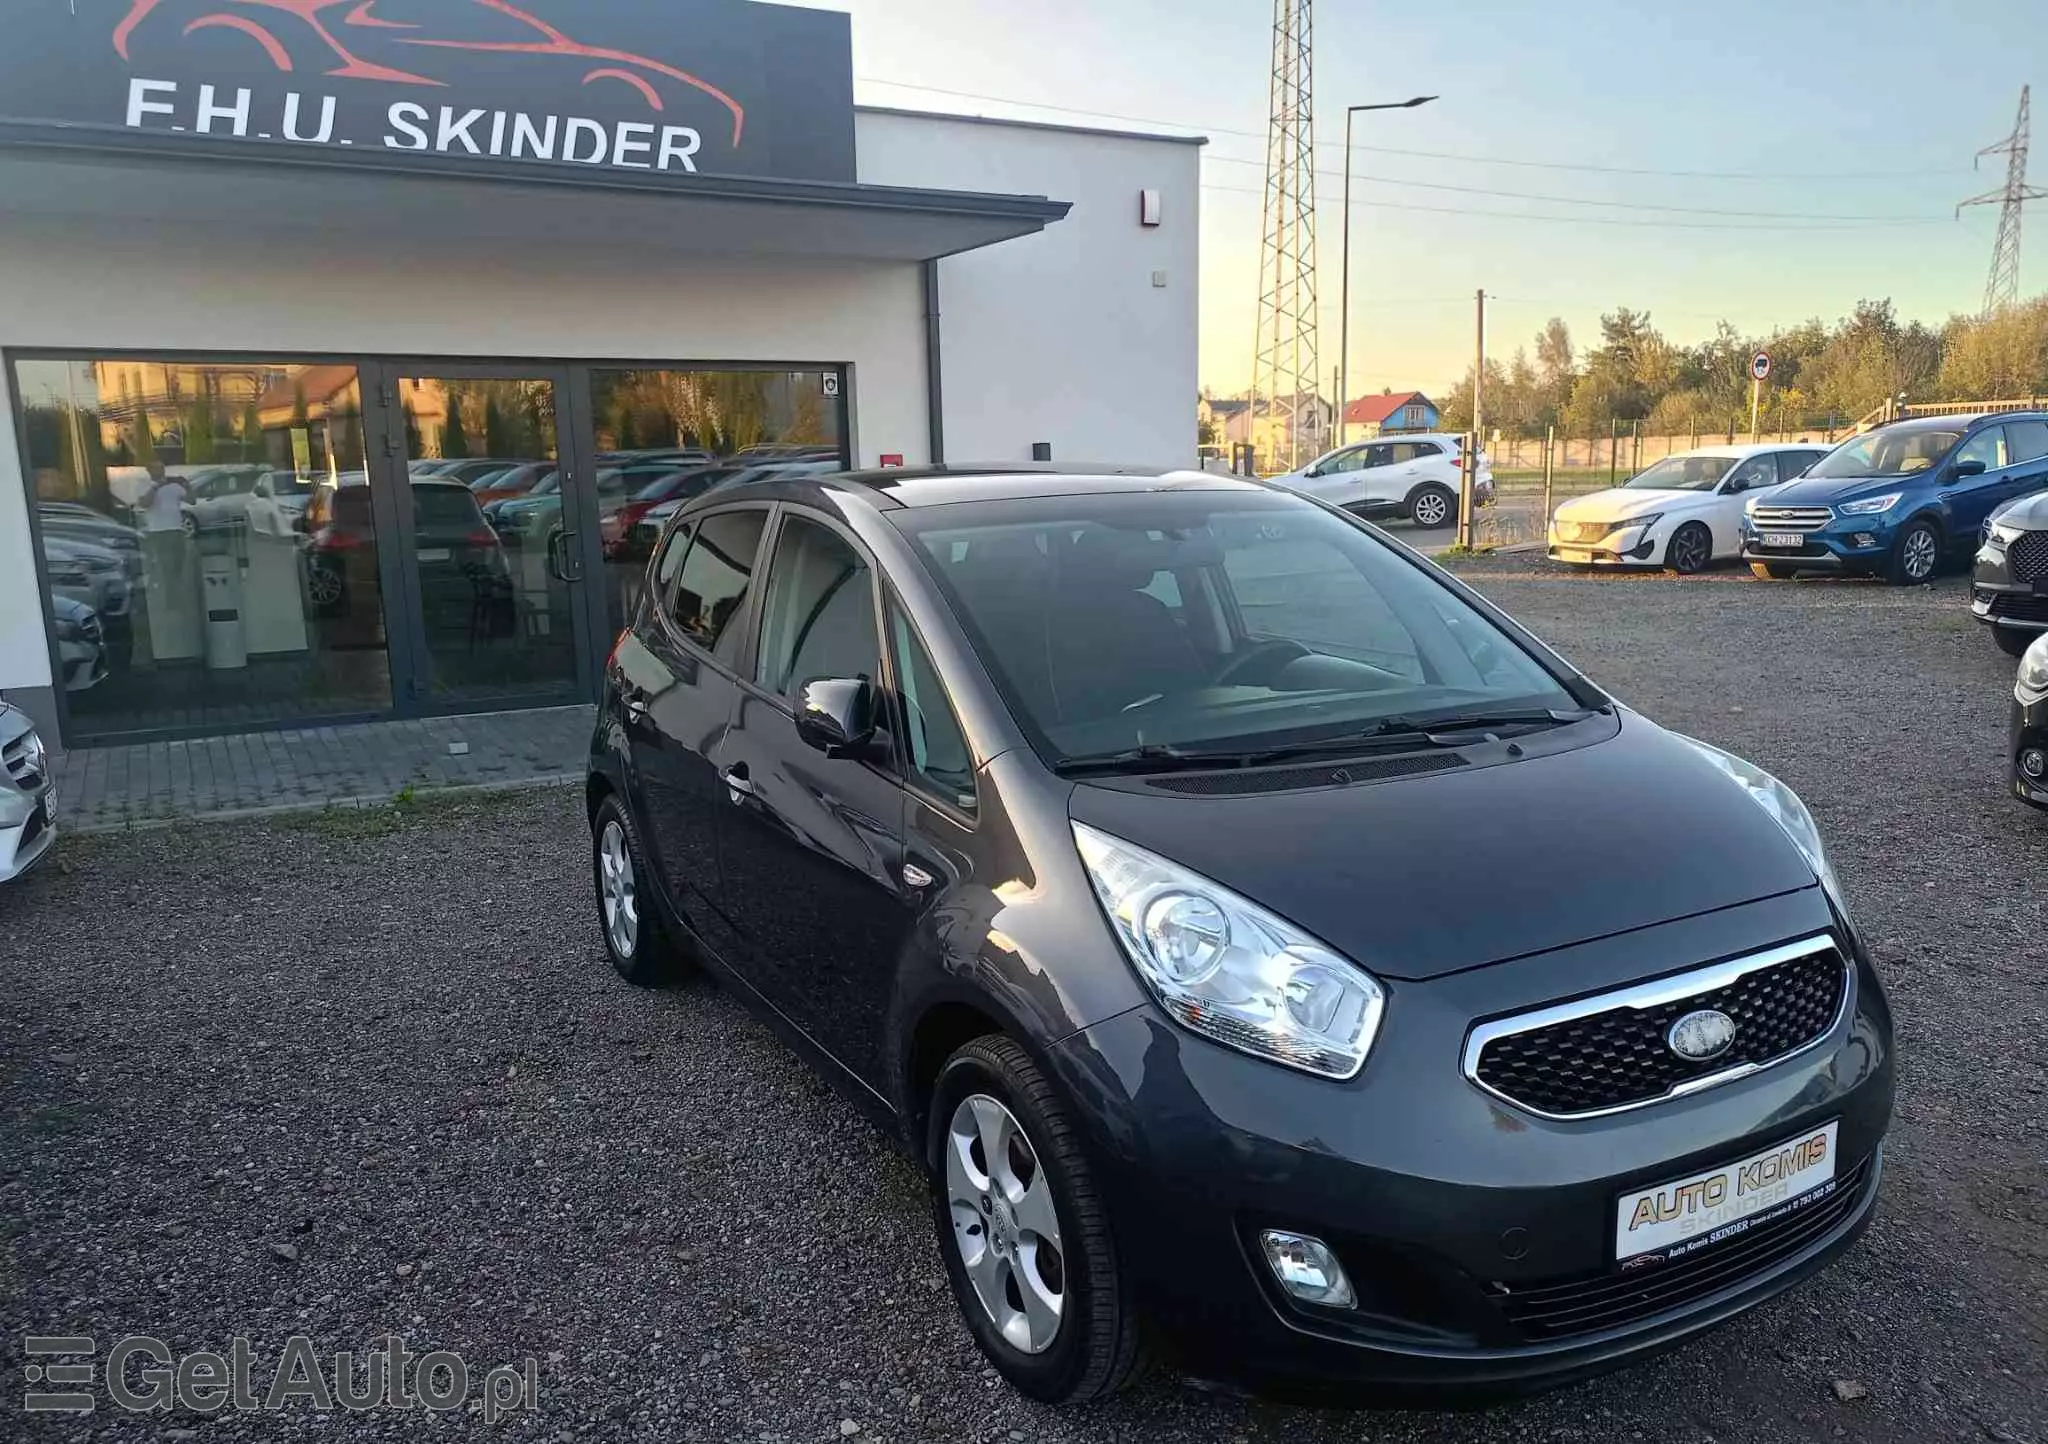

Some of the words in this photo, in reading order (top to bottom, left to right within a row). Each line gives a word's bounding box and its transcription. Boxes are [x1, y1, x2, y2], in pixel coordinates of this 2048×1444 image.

[383, 101, 702, 173] SKINDER
[1628, 1173, 1728, 1232] AUTO
[1736, 1132, 1828, 1197] KOMIS
[1679, 1181, 1789, 1235] SKINDER
[1668, 1245, 1687, 1259] Auto
[1687, 1237, 1709, 1251] Komis
[1709, 1219, 1750, 1244] SKINDER
